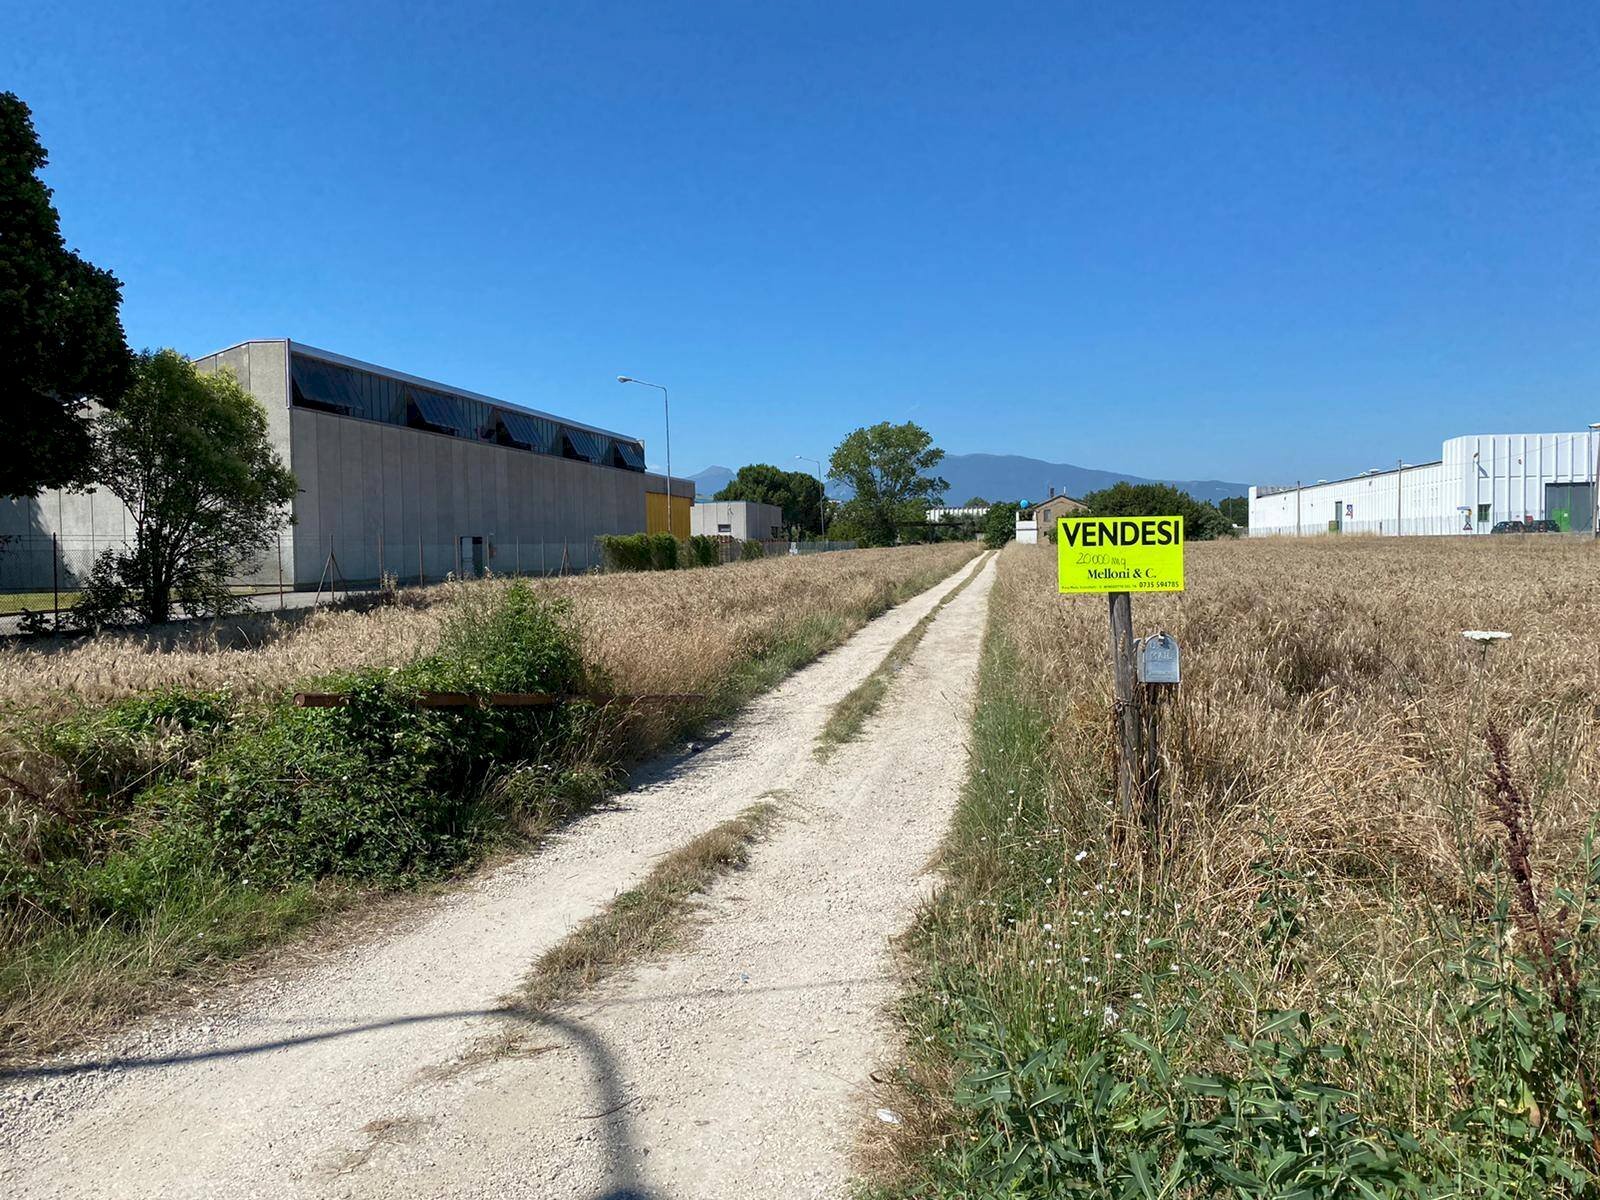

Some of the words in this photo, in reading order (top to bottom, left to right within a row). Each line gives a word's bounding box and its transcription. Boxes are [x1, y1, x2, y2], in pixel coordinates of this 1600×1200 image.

[1062, 520, 1179, 547] VENDESI
[1087, 568, 1130, 579] Melloni
[1133, 568, 1142, 578] &
[1146, 568, 1157, 578] C.
